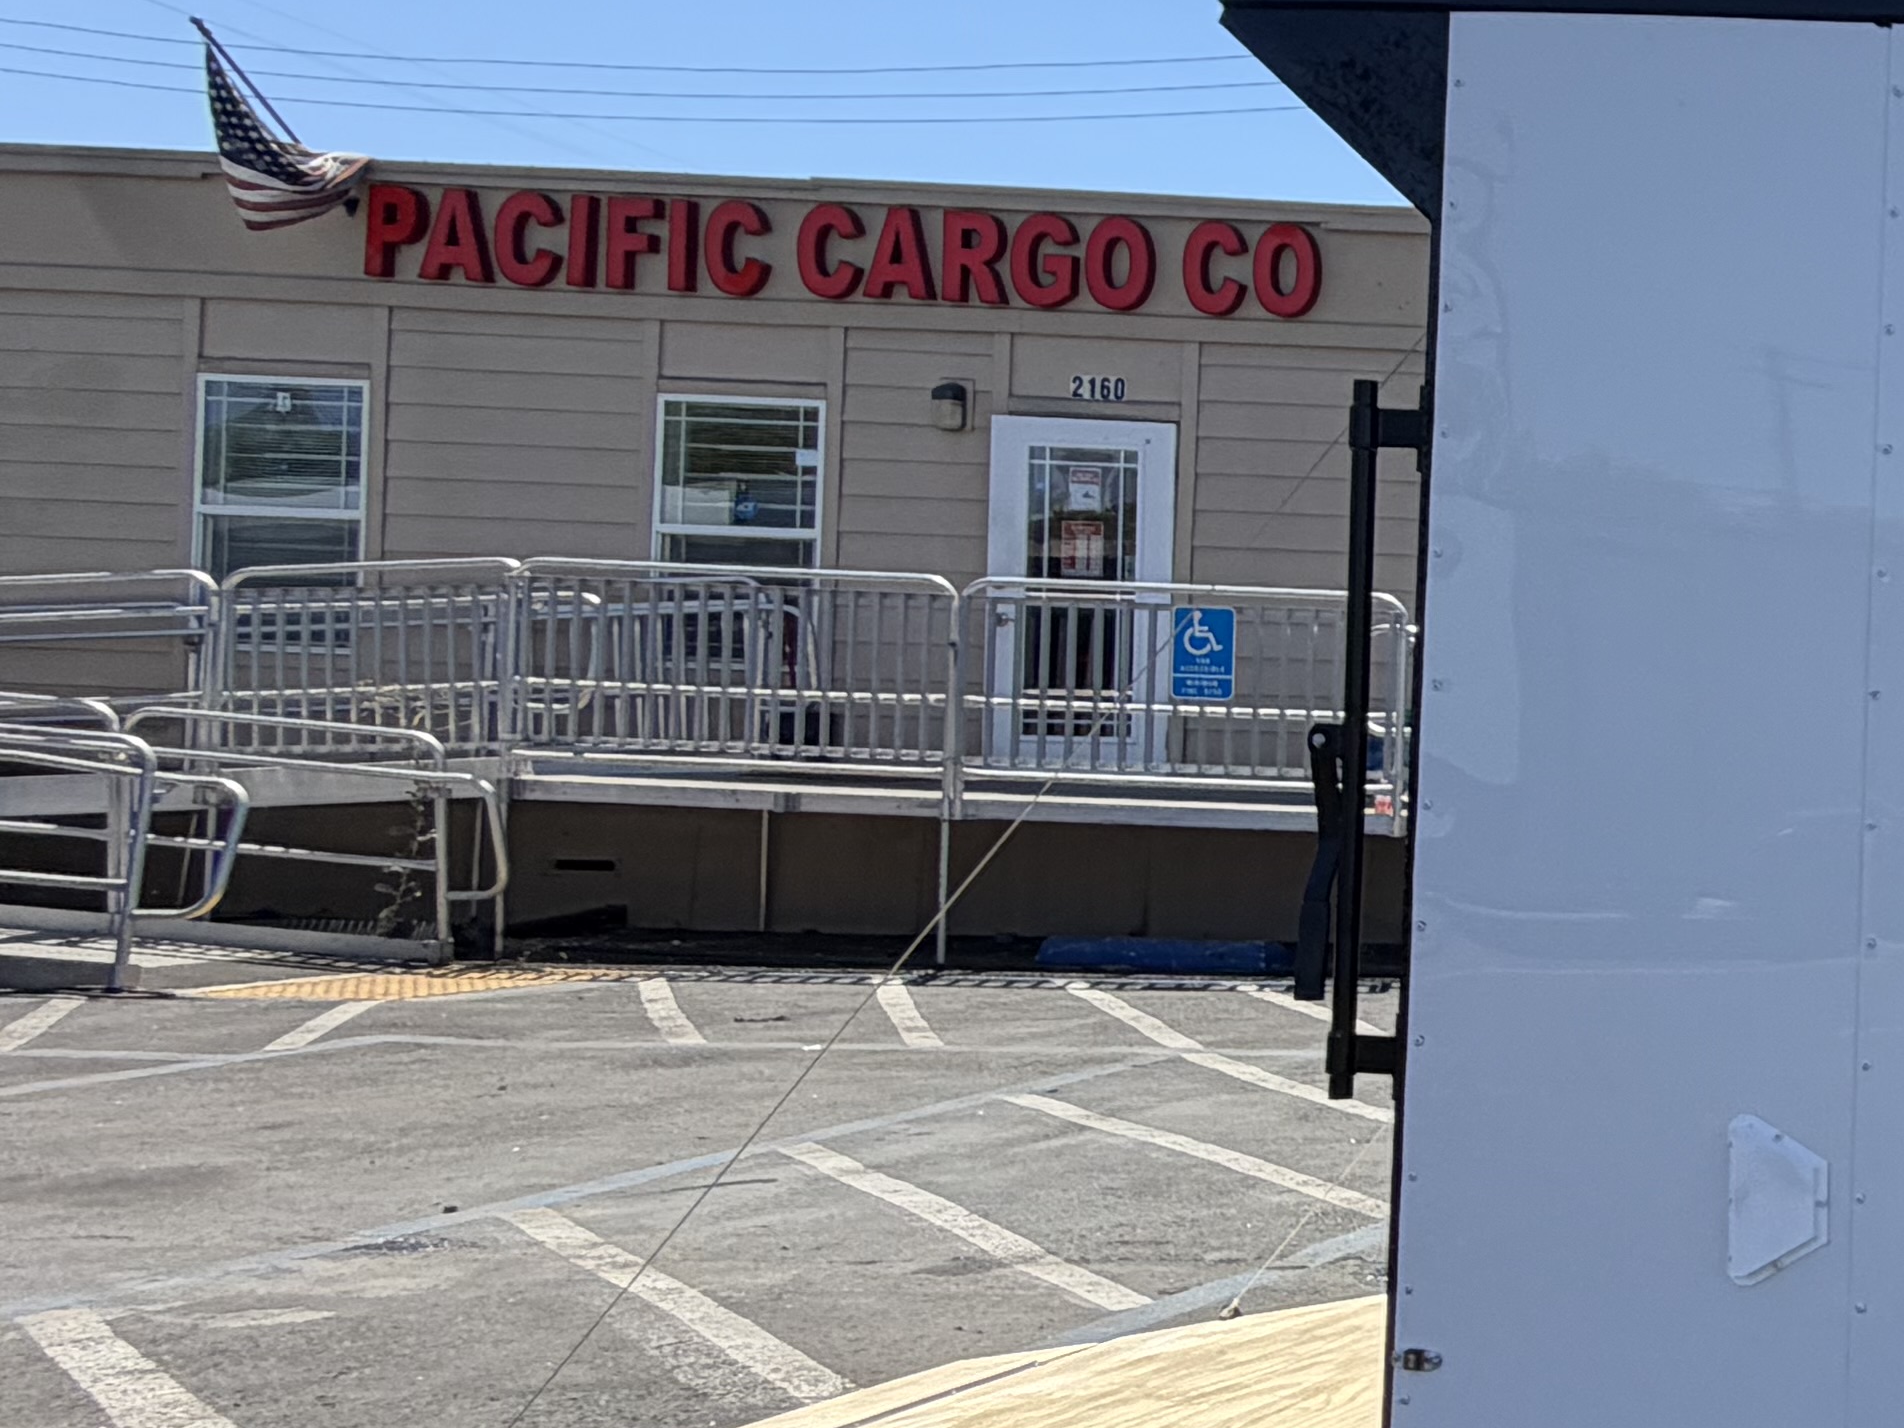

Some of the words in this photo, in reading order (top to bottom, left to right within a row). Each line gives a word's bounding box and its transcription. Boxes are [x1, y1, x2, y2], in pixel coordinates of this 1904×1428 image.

[363, 183, 772, 297] PACIFIC
[796, 202, 1157, 312] CARGO
[1182, 219, 1322, 319] CO
[1071, 376, 1126, 401] 2160
